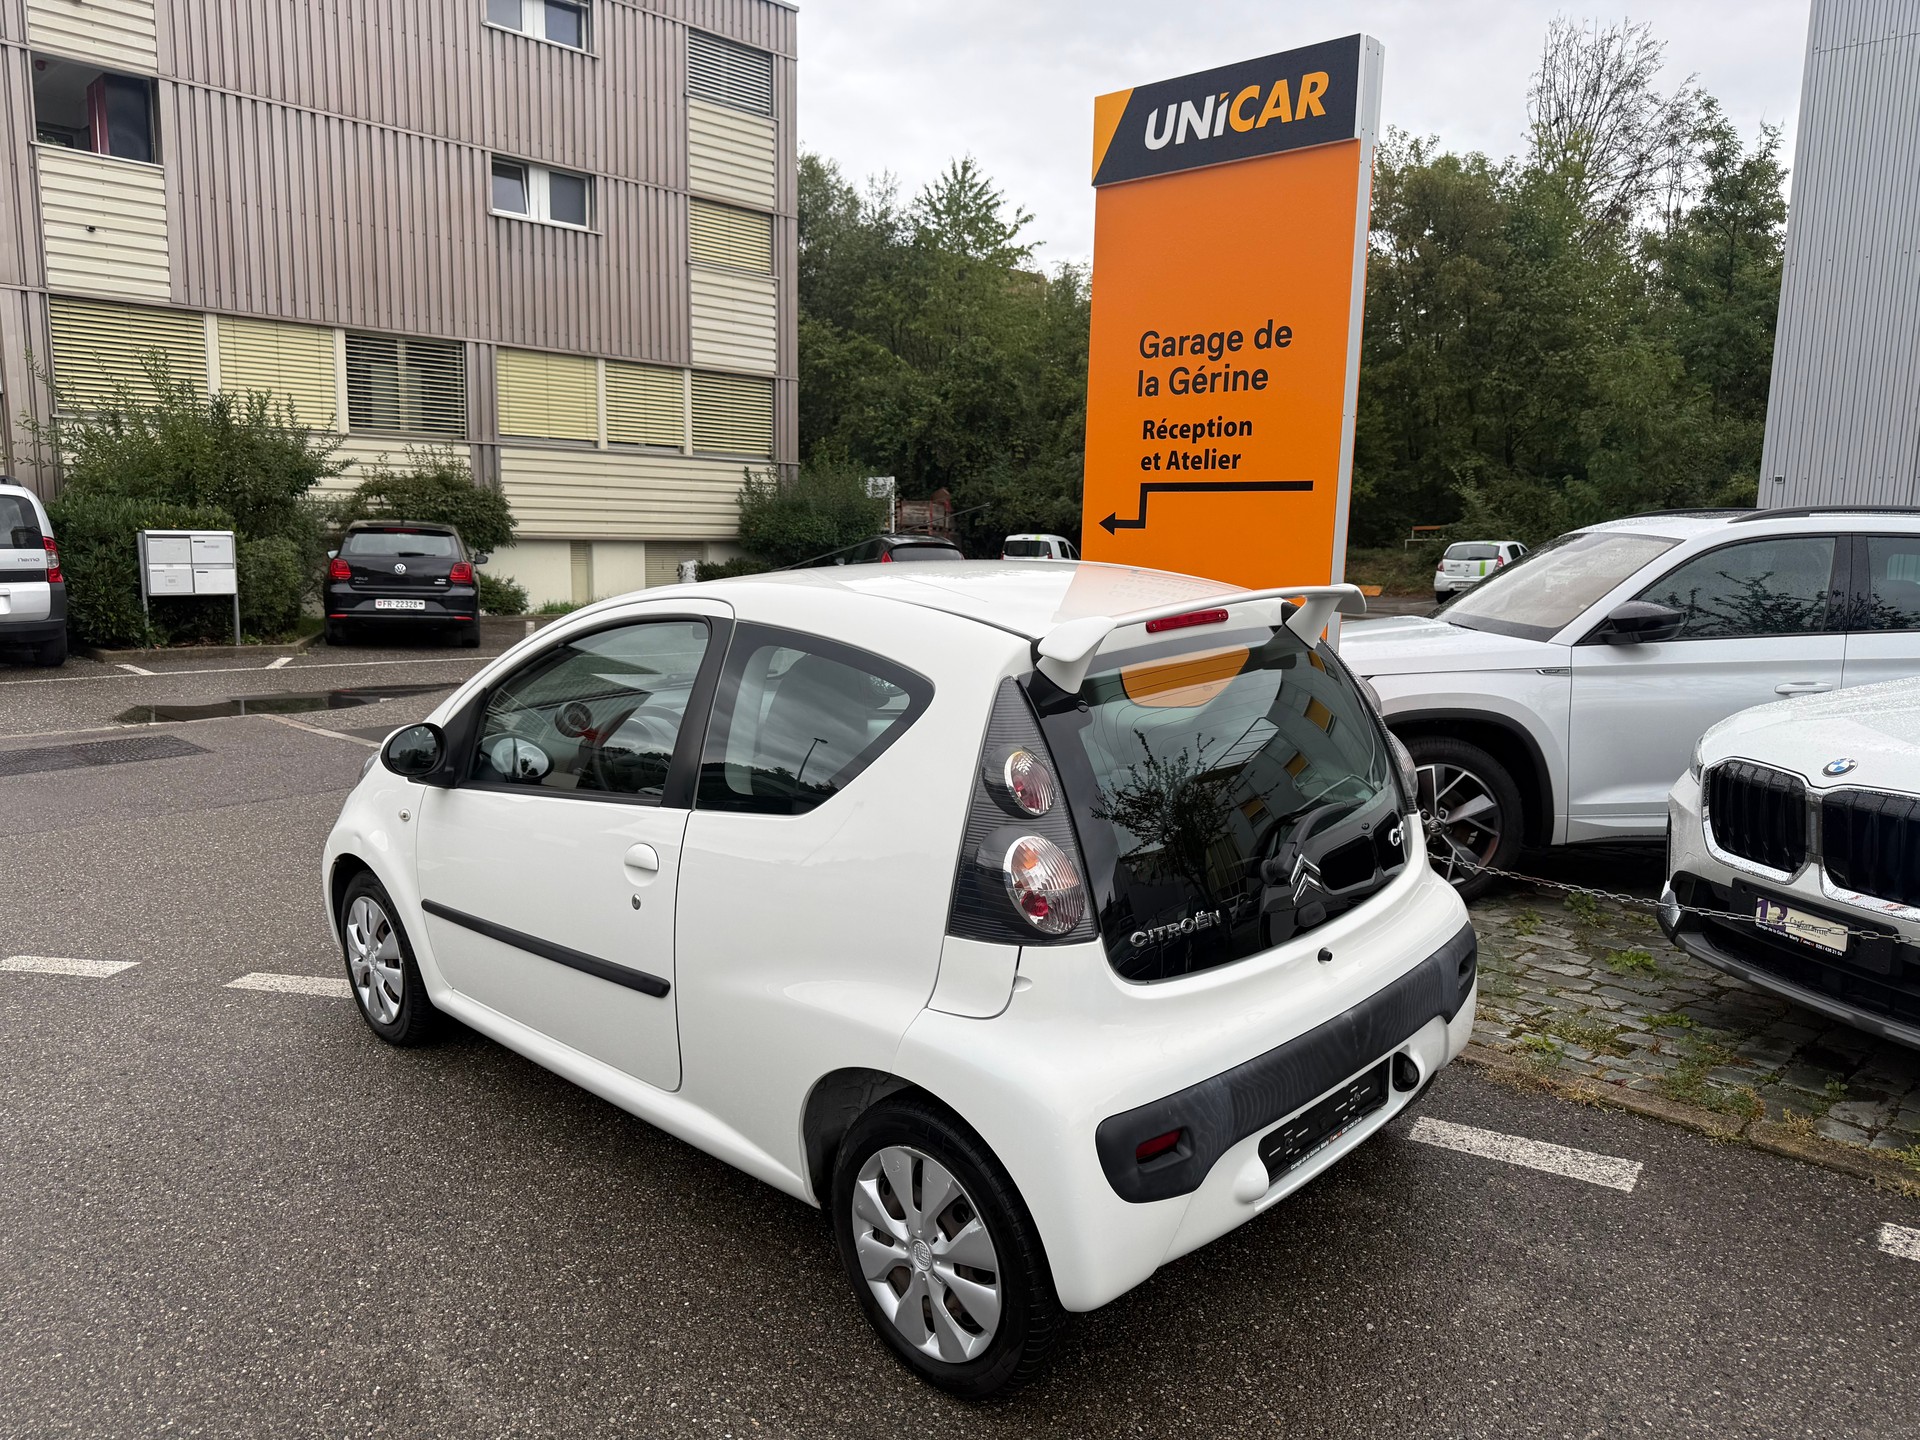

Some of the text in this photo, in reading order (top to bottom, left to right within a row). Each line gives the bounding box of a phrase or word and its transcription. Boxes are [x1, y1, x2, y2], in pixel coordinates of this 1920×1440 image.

[1139, 319, 1293, 362] Garage de
[1137, 363, 1269, 398] la Gérine
[1142, 415, 1253, 444] Réception
[1140, 448, 1242, 471] et Atelier
[1130, 910, 1221, 948] CITROËN
